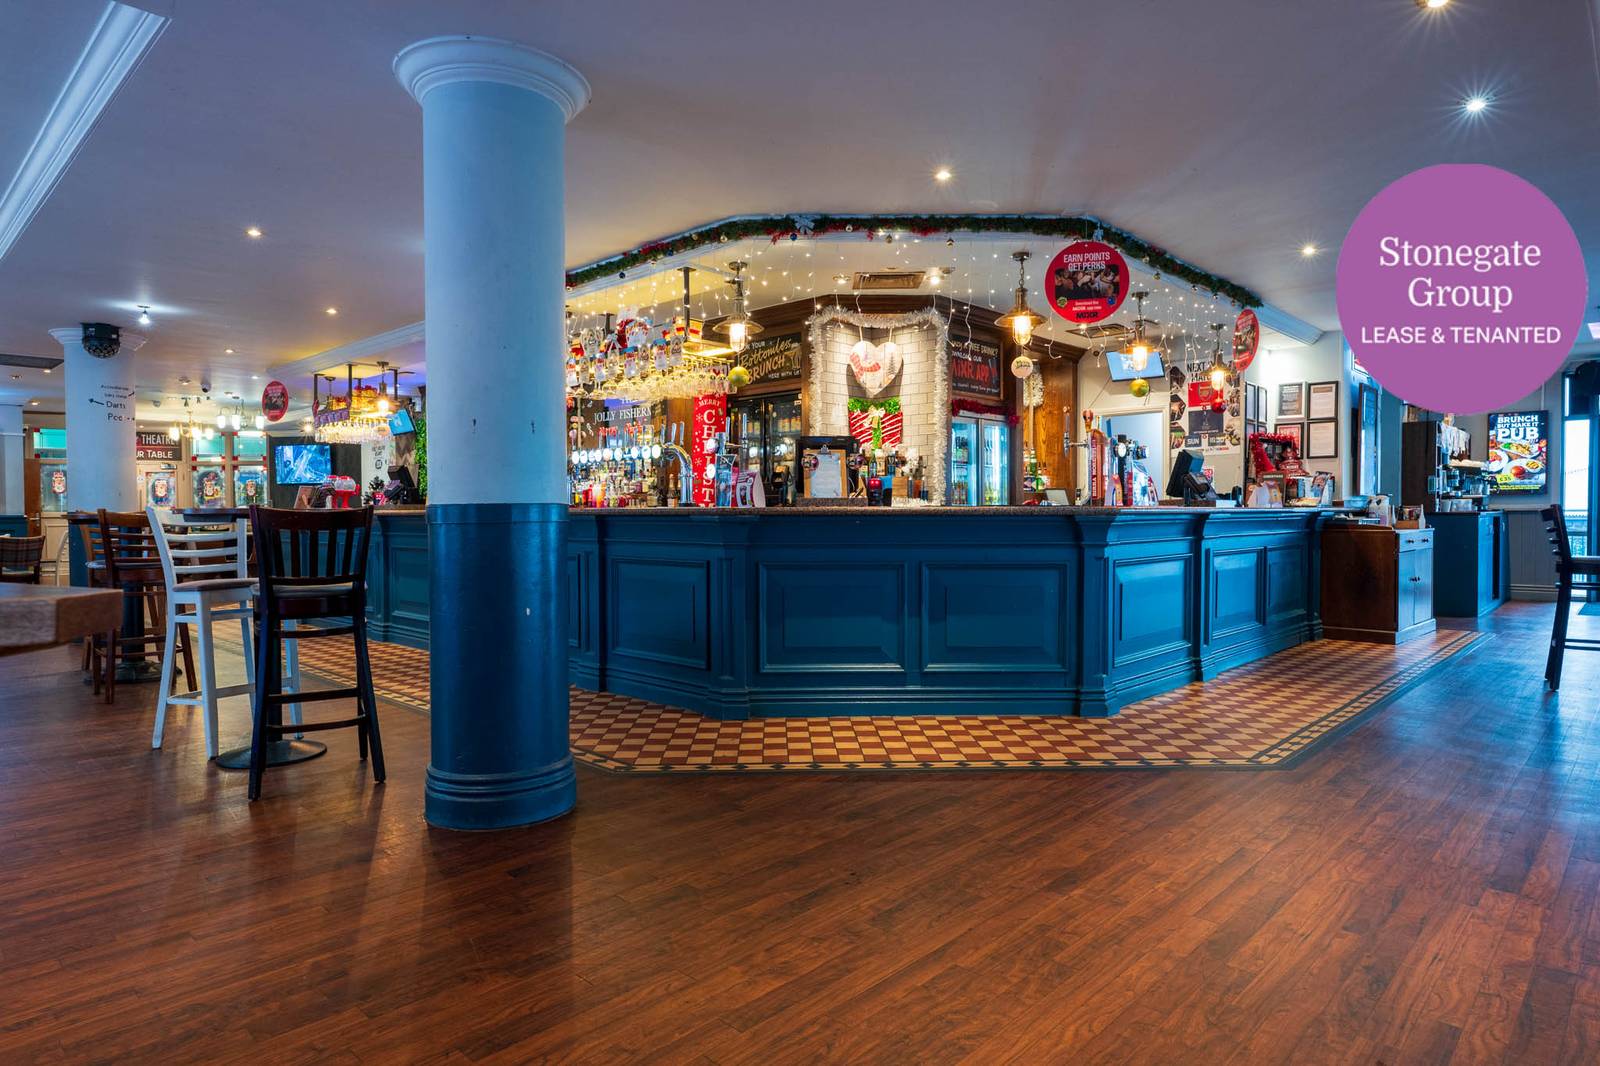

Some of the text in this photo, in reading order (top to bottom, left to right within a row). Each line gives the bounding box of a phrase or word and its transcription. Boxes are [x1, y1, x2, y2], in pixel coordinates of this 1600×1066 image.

[1063, 252, 1110, 263] EARN POINTS
[1068, 261, 1105, 272] GET PERKS
[593, 409, 616, 425] JOLLY
[1497, 415, 1539, 423] BRUNCH
[1497, 427, 1539, 441] PUB
[1187, 438, 1200, 446] SUN
[146, 449, 173, 459] TABLE
